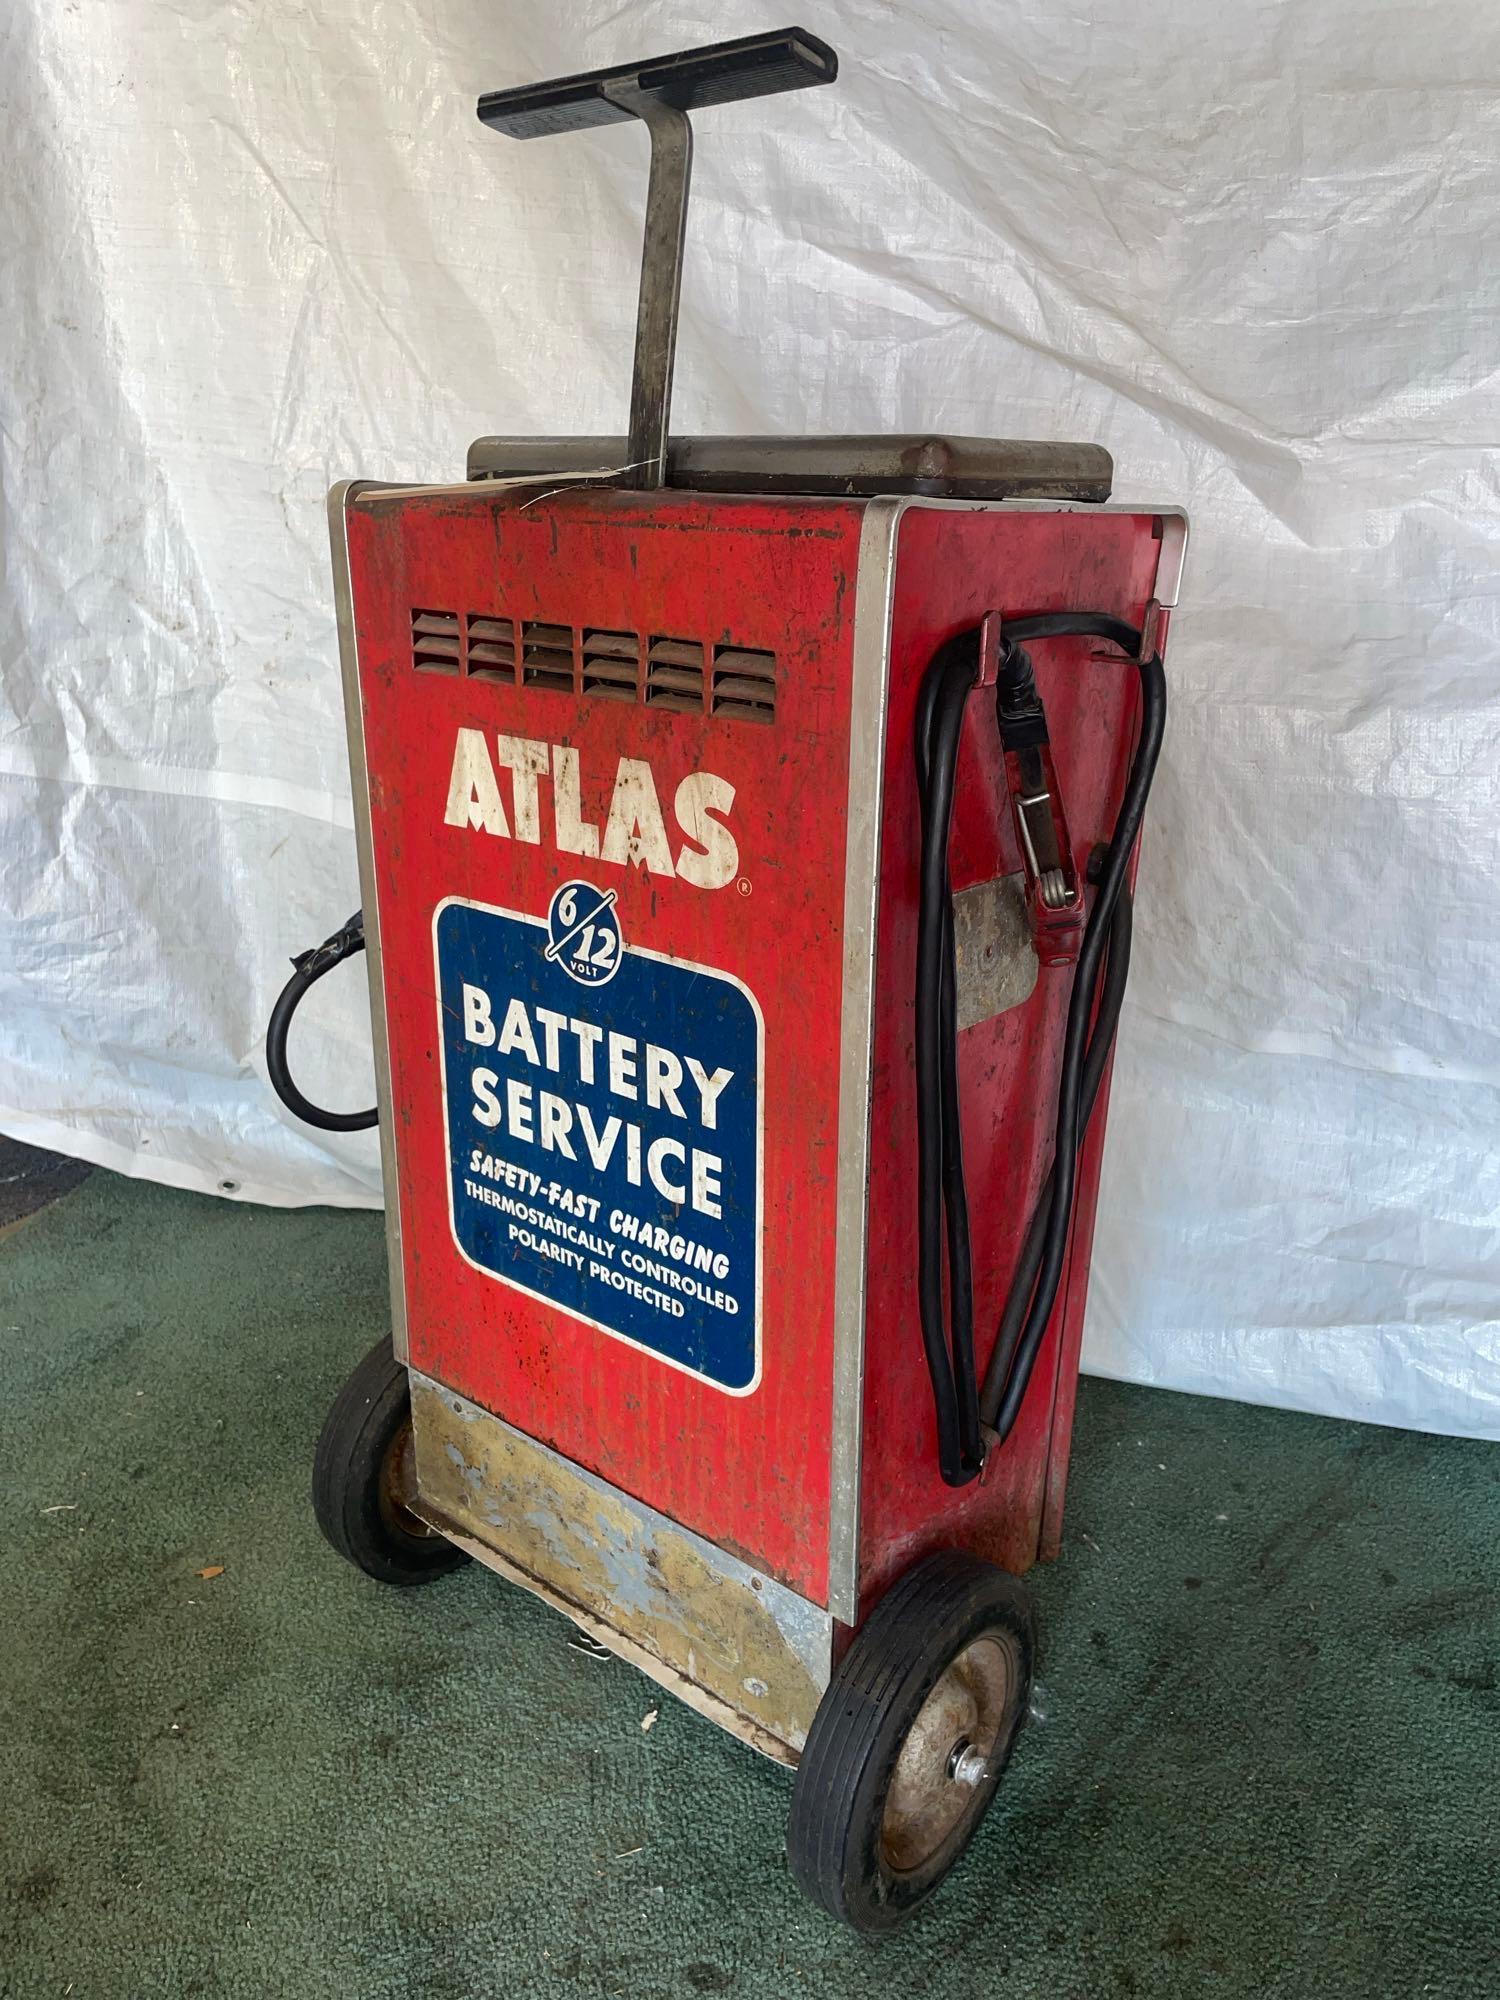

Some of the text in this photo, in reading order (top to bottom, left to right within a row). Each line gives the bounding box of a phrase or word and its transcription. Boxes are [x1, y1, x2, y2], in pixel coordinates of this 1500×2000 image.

[443, 726, 740, 890] ATLAS
[570, 959, 599, 979] VOLT
[462, 983, 735, 1130] BATTERY
[471, 1066, 723, 1220] SERVICE
[464, 1179, 739, 1315] THERMOSTATICALLY CONTROLLED
[469, 1150, 730, 1280] SAFETY-FAST CHARGING
[508, 1224, 685, 1318] POLARITY PROTECTED
